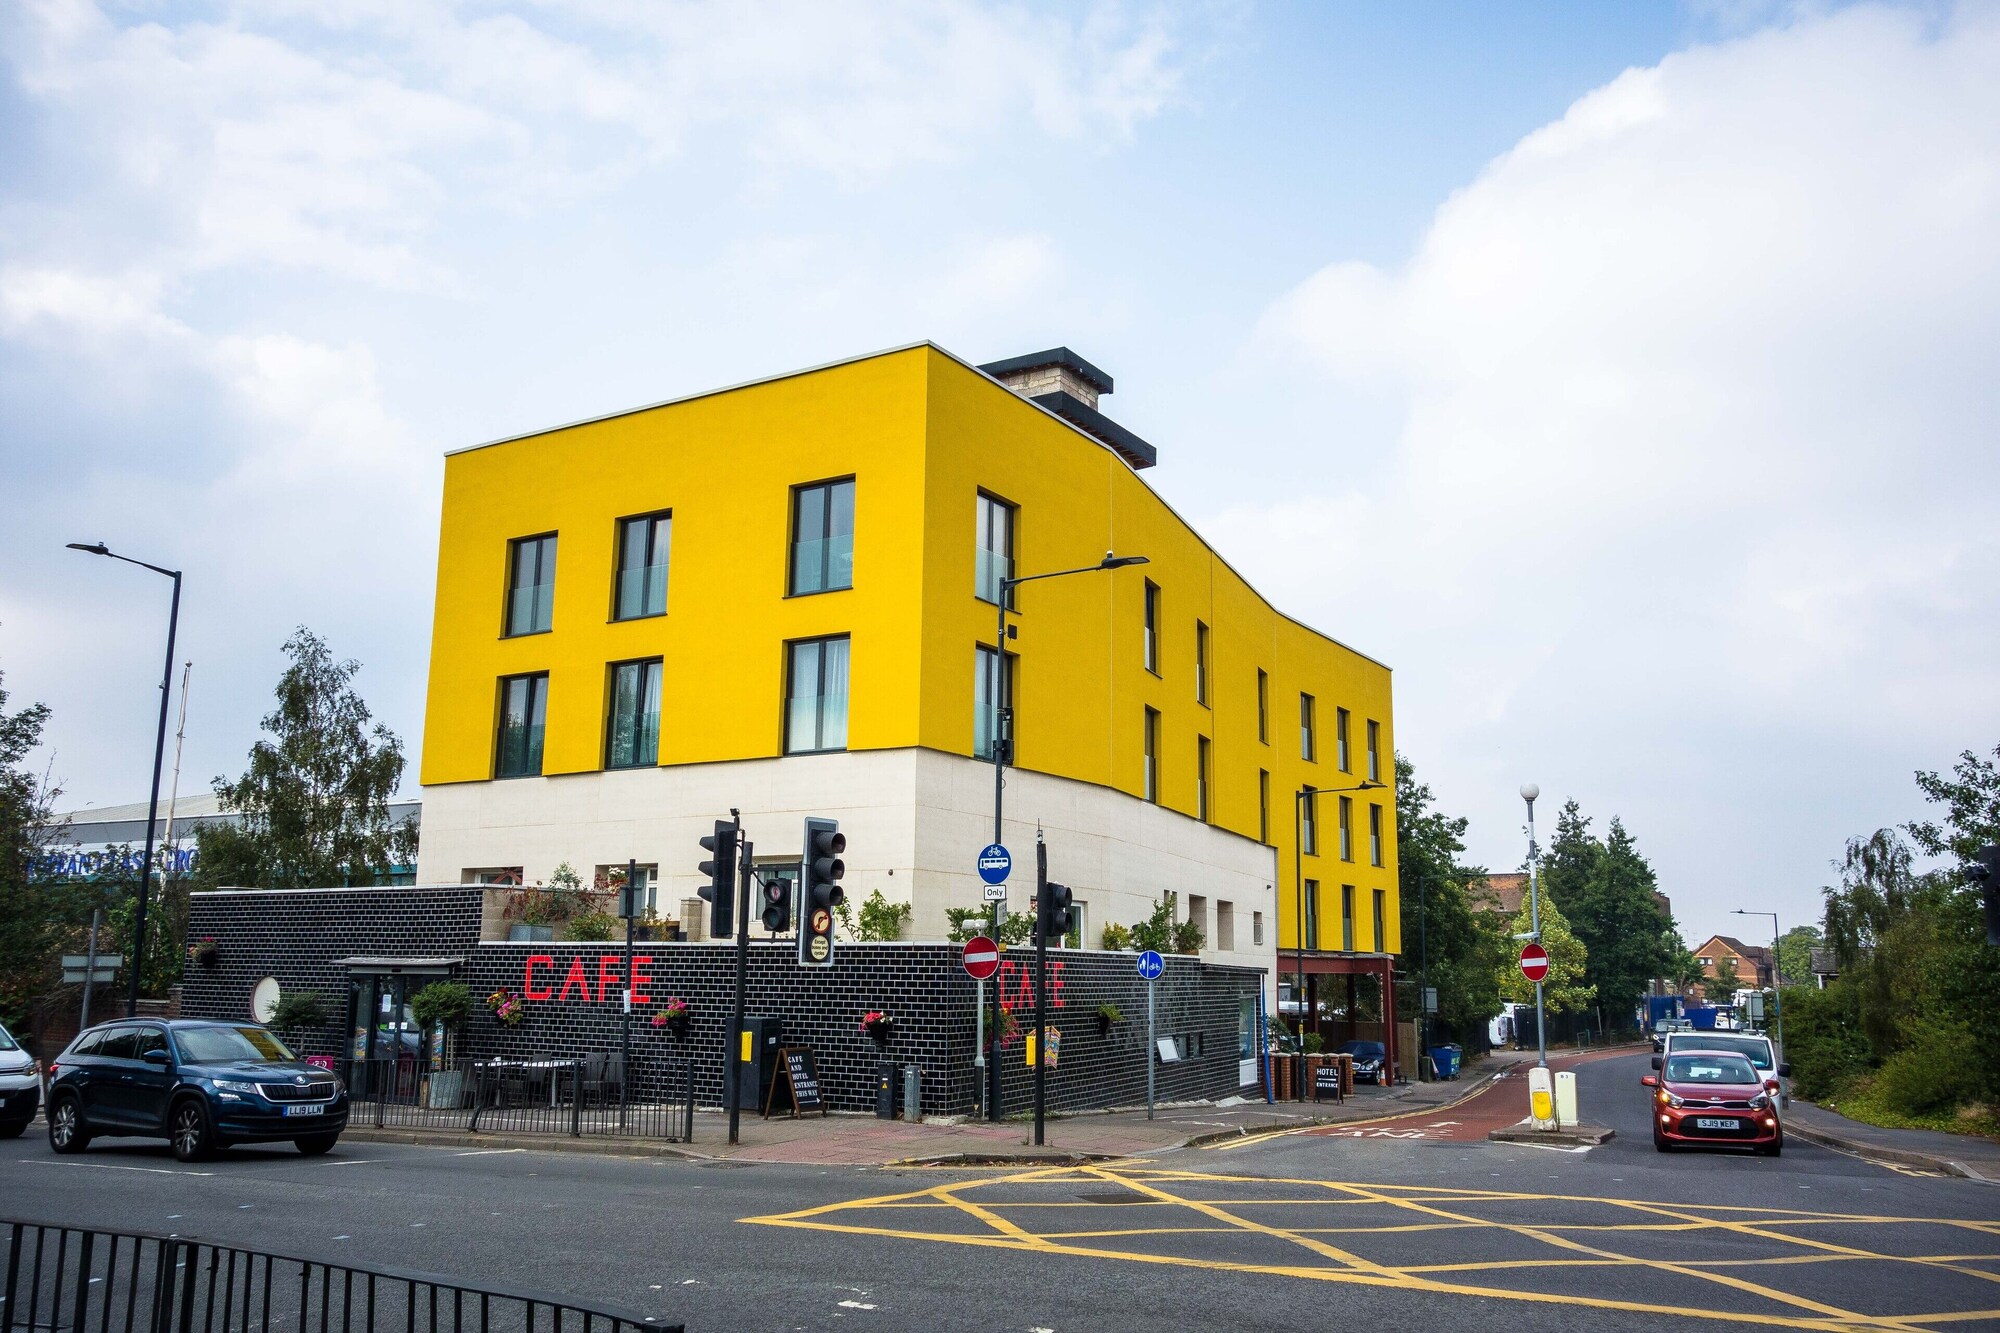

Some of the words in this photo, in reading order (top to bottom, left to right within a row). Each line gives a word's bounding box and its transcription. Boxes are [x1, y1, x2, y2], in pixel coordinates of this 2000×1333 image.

[987, 889, 1003, 897] Only
[525, 955, 652, 1003] CAFE
[1001, 961, 1065, 1008] CAE
[794, 1081, 818, 1089] ENTRANCE
[290, 1106, 306, 1114] LL19
[308, 1106, 322, 1114] LLN
